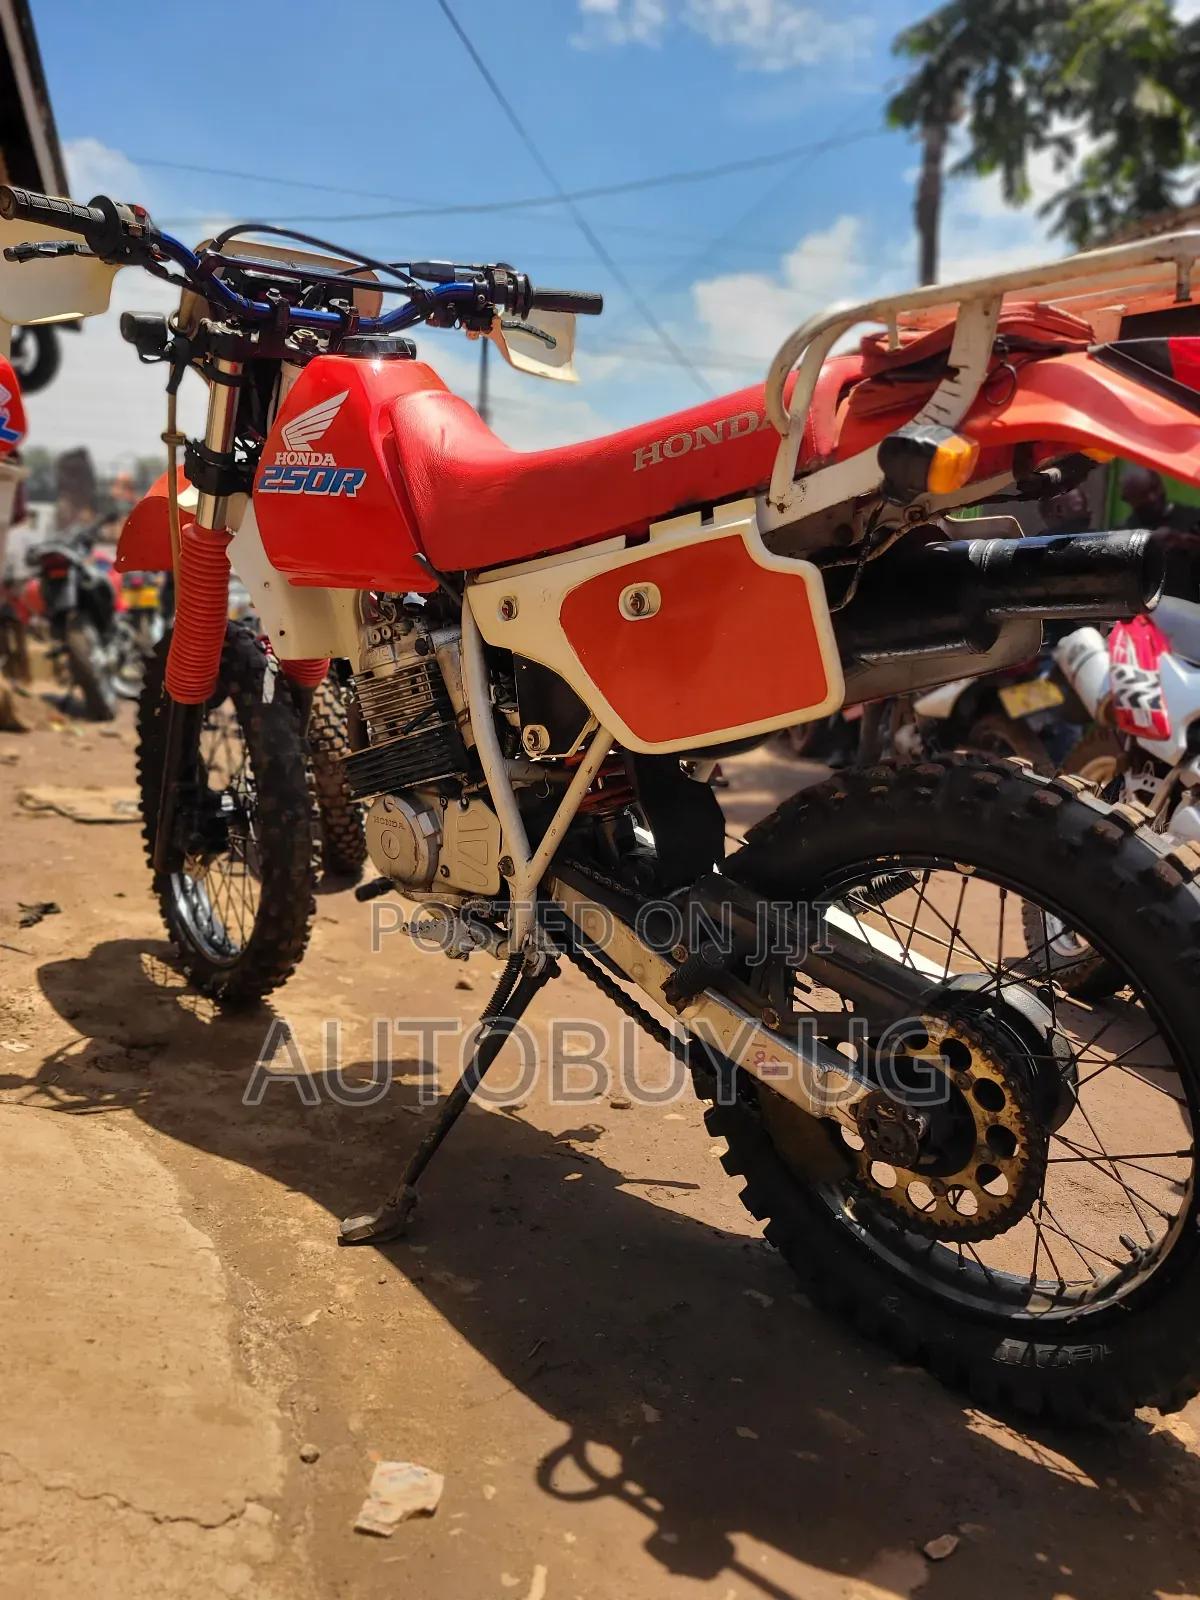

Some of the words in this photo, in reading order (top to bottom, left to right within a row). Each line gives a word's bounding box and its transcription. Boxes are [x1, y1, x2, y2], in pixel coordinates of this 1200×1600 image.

[275, 451, 337, 467] HONDA
[258, 466, 367, 498] 250R
[373, 815, 406, 830] HONDA
